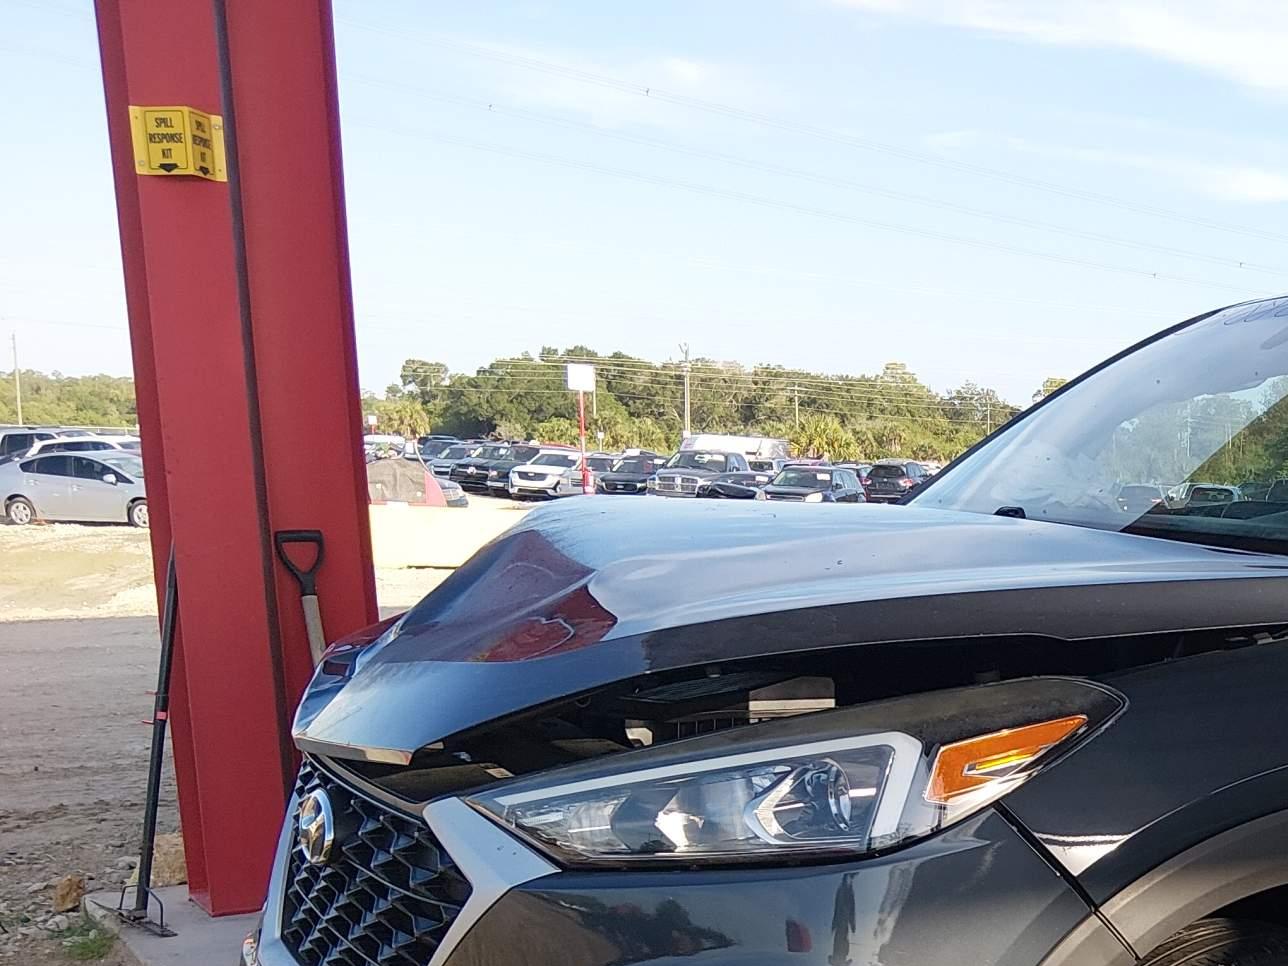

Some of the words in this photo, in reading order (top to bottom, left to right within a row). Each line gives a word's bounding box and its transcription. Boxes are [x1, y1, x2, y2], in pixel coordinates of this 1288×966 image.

[154, 117, 175, 129] SPILL
[148, 132, 184, 144] RESPONSE
[161, 148, 173, 160] KIT
